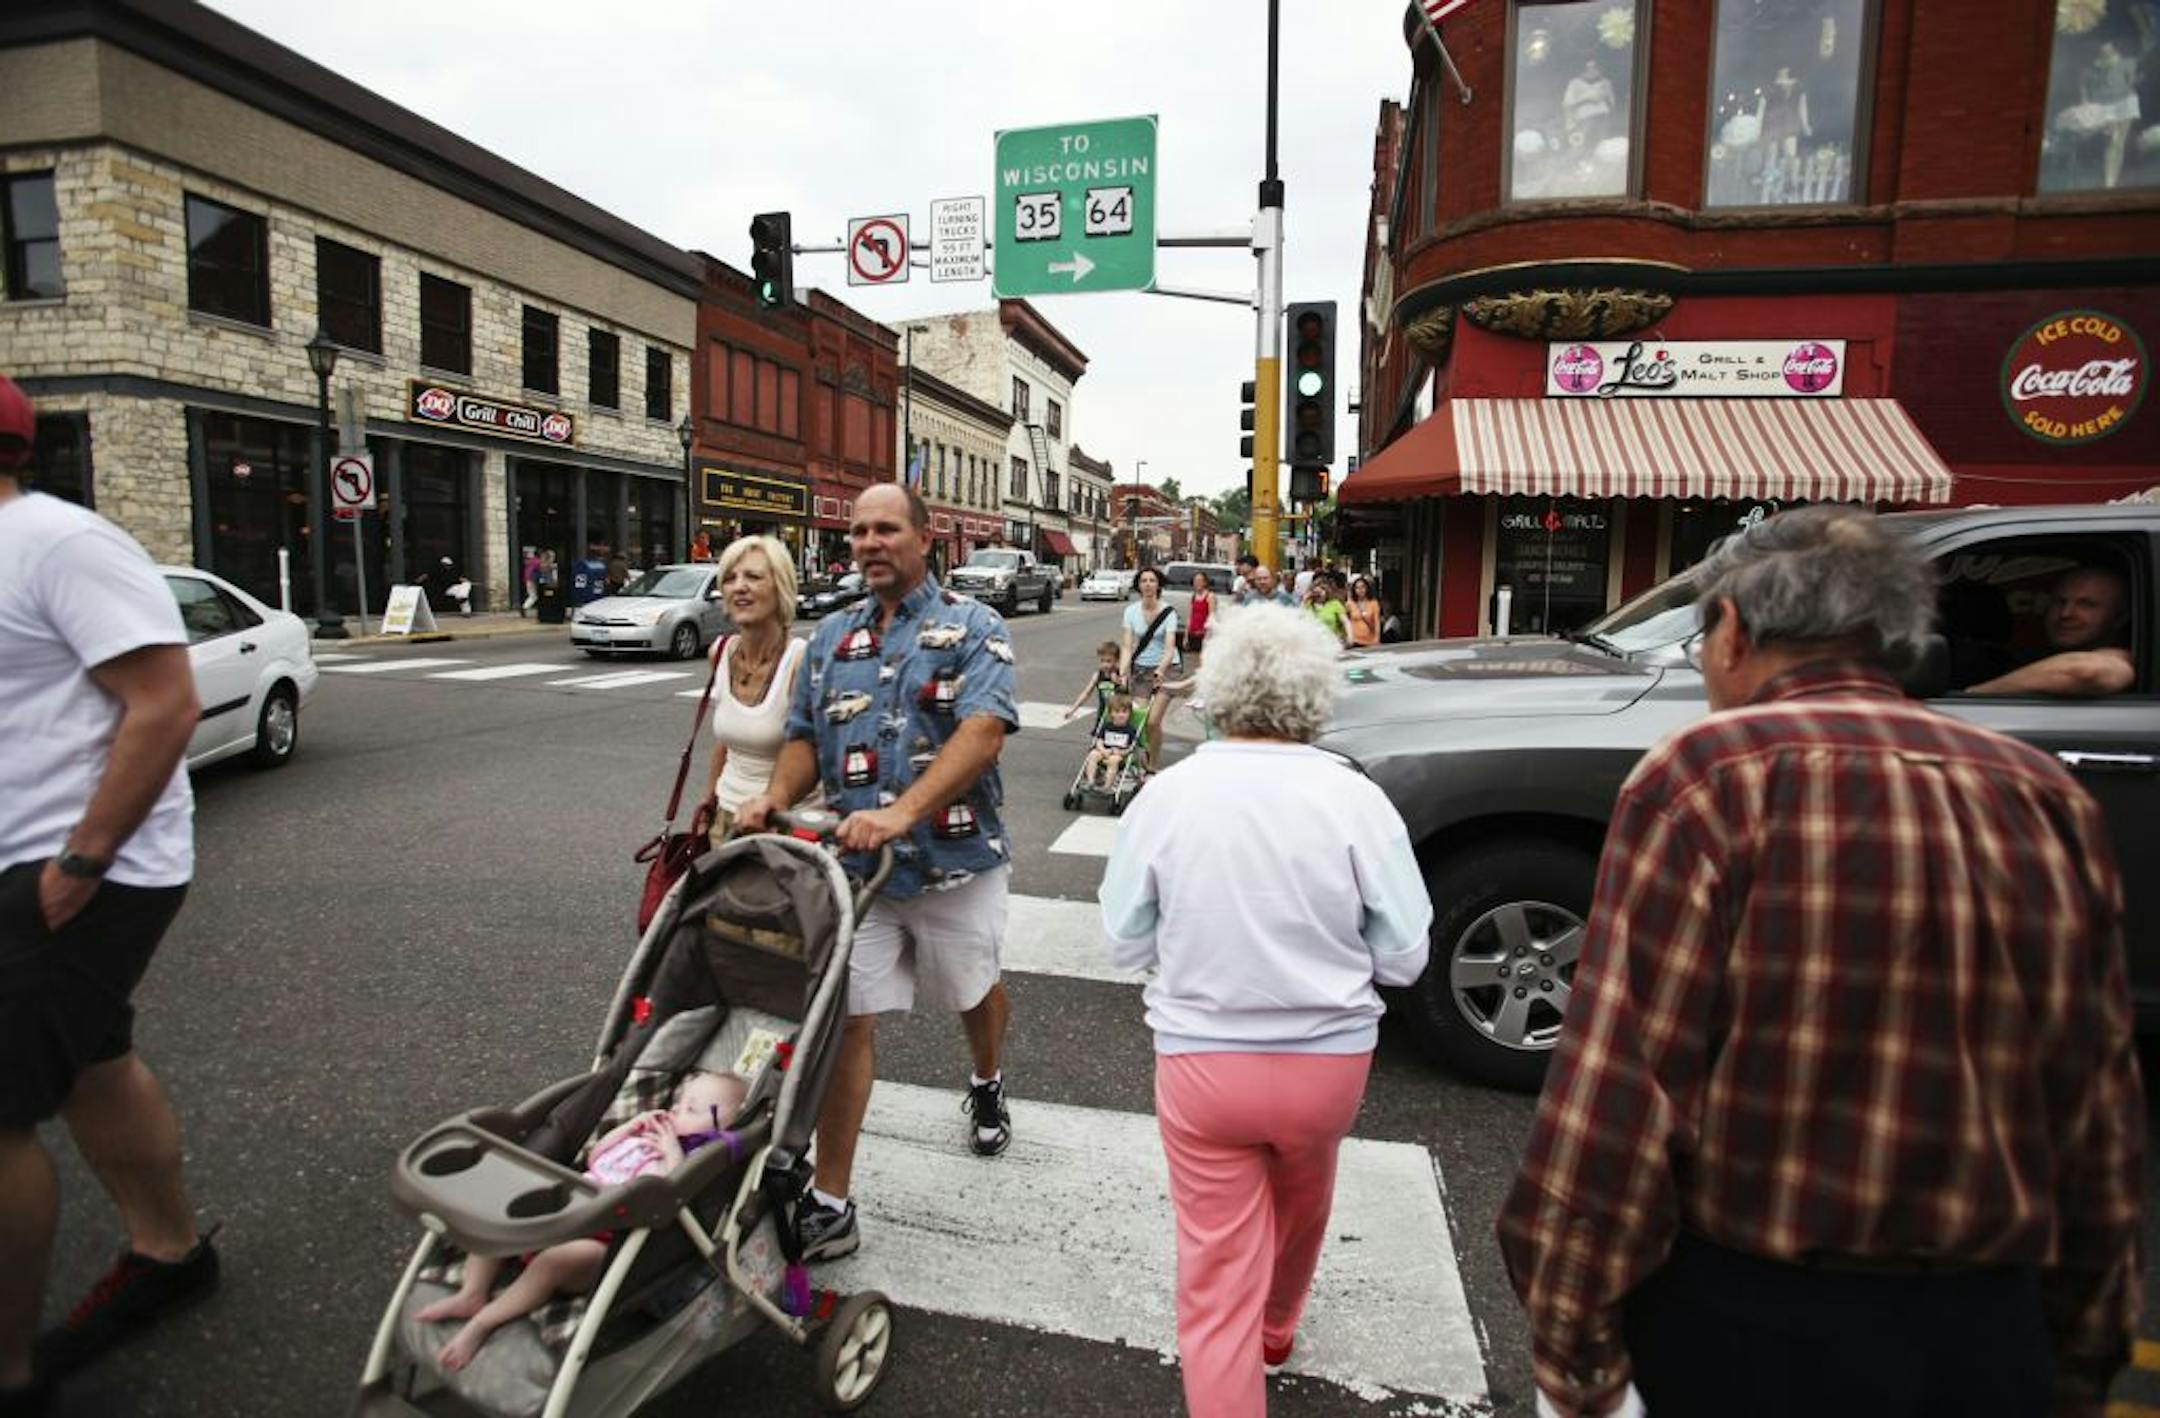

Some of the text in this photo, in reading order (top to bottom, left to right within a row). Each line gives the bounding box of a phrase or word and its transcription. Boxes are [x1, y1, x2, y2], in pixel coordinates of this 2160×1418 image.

[1060, 134, 1090, 154] TO
[1003, 157, 1149, 187] WISCONSIN
[938, 214, 979, 225] TURNING
[1020, 202, 1056, 229] 35
[1090, 197, 1128, 225] 64
[940, 226, 977, 237] TRUCKS
[934, 255, 980, 264] MAXIMUM
[938, 266, 975, 277] LENGTH
[2036, 317, 2121, 345] ICE COLD
[465, 404, 498, 424] Grill
[506, 411, 536, 430] Chill
[2024, 405, 2124, 438] SOLD HERE
